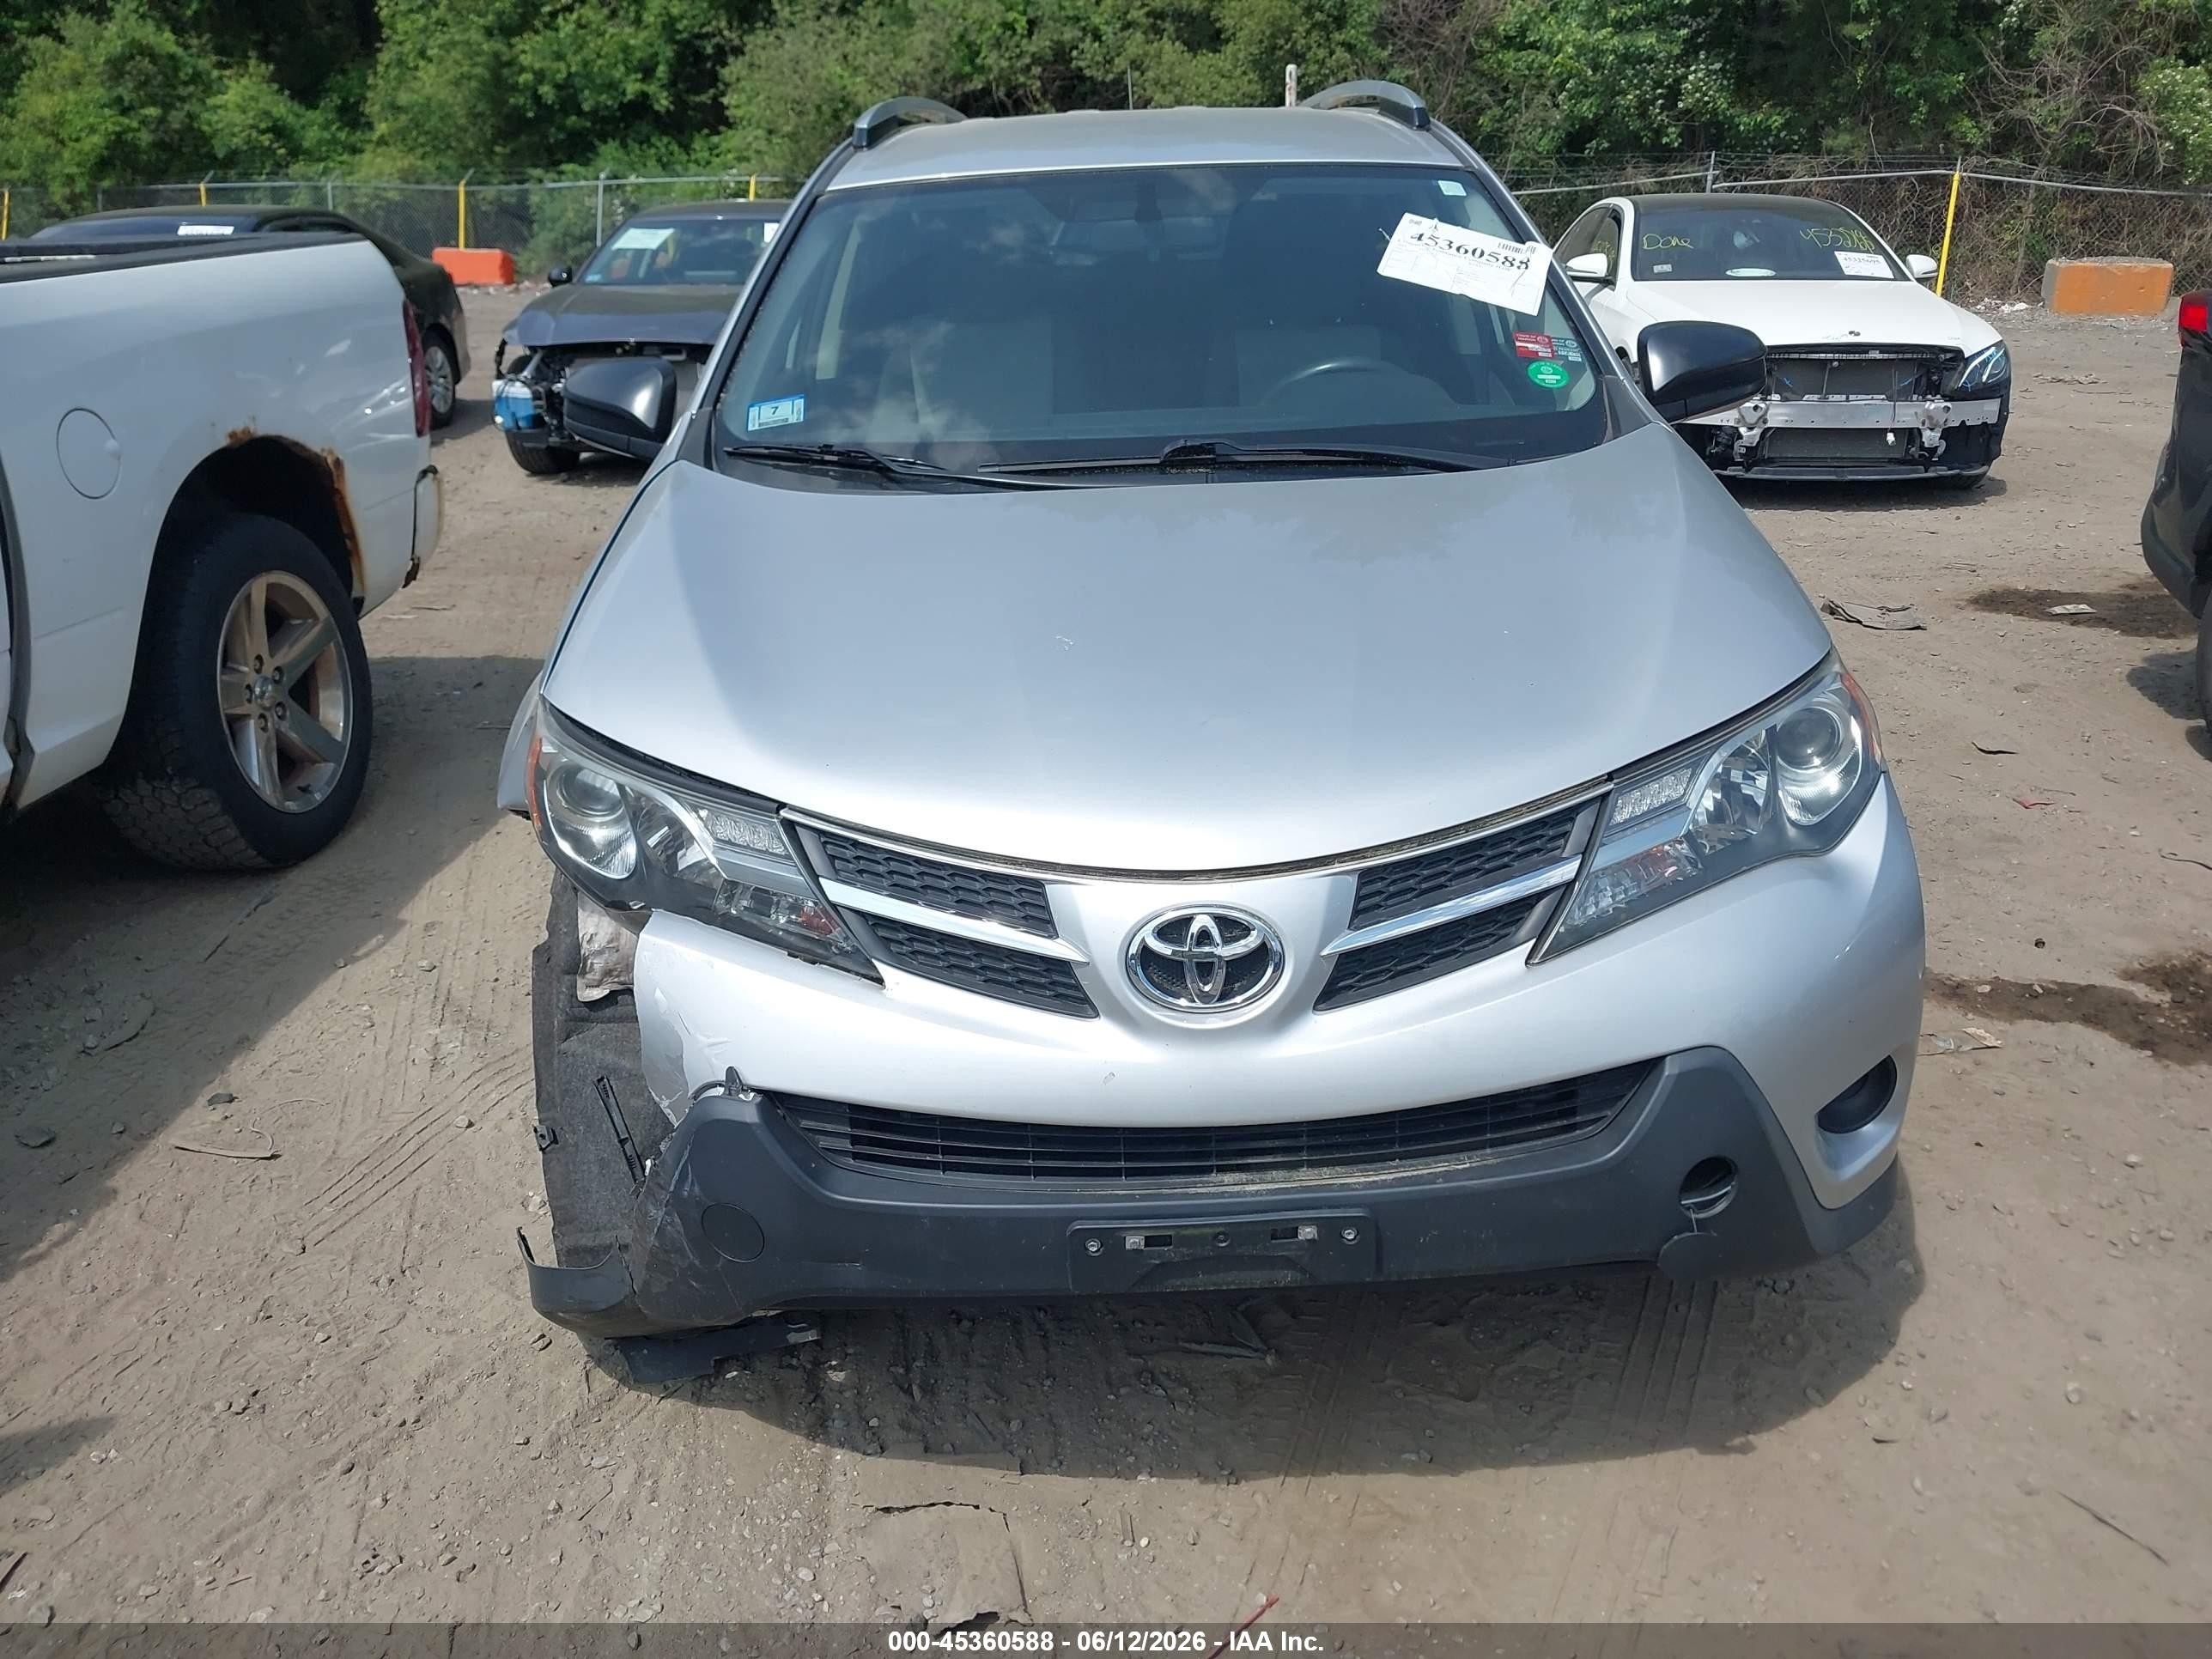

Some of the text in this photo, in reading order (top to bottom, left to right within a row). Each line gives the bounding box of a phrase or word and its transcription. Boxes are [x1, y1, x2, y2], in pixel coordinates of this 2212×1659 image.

[1643, 233, 1694, 249] Done
[1410, 231, 1531, 270] 45360588
[770, 405, 779, 416] 7
